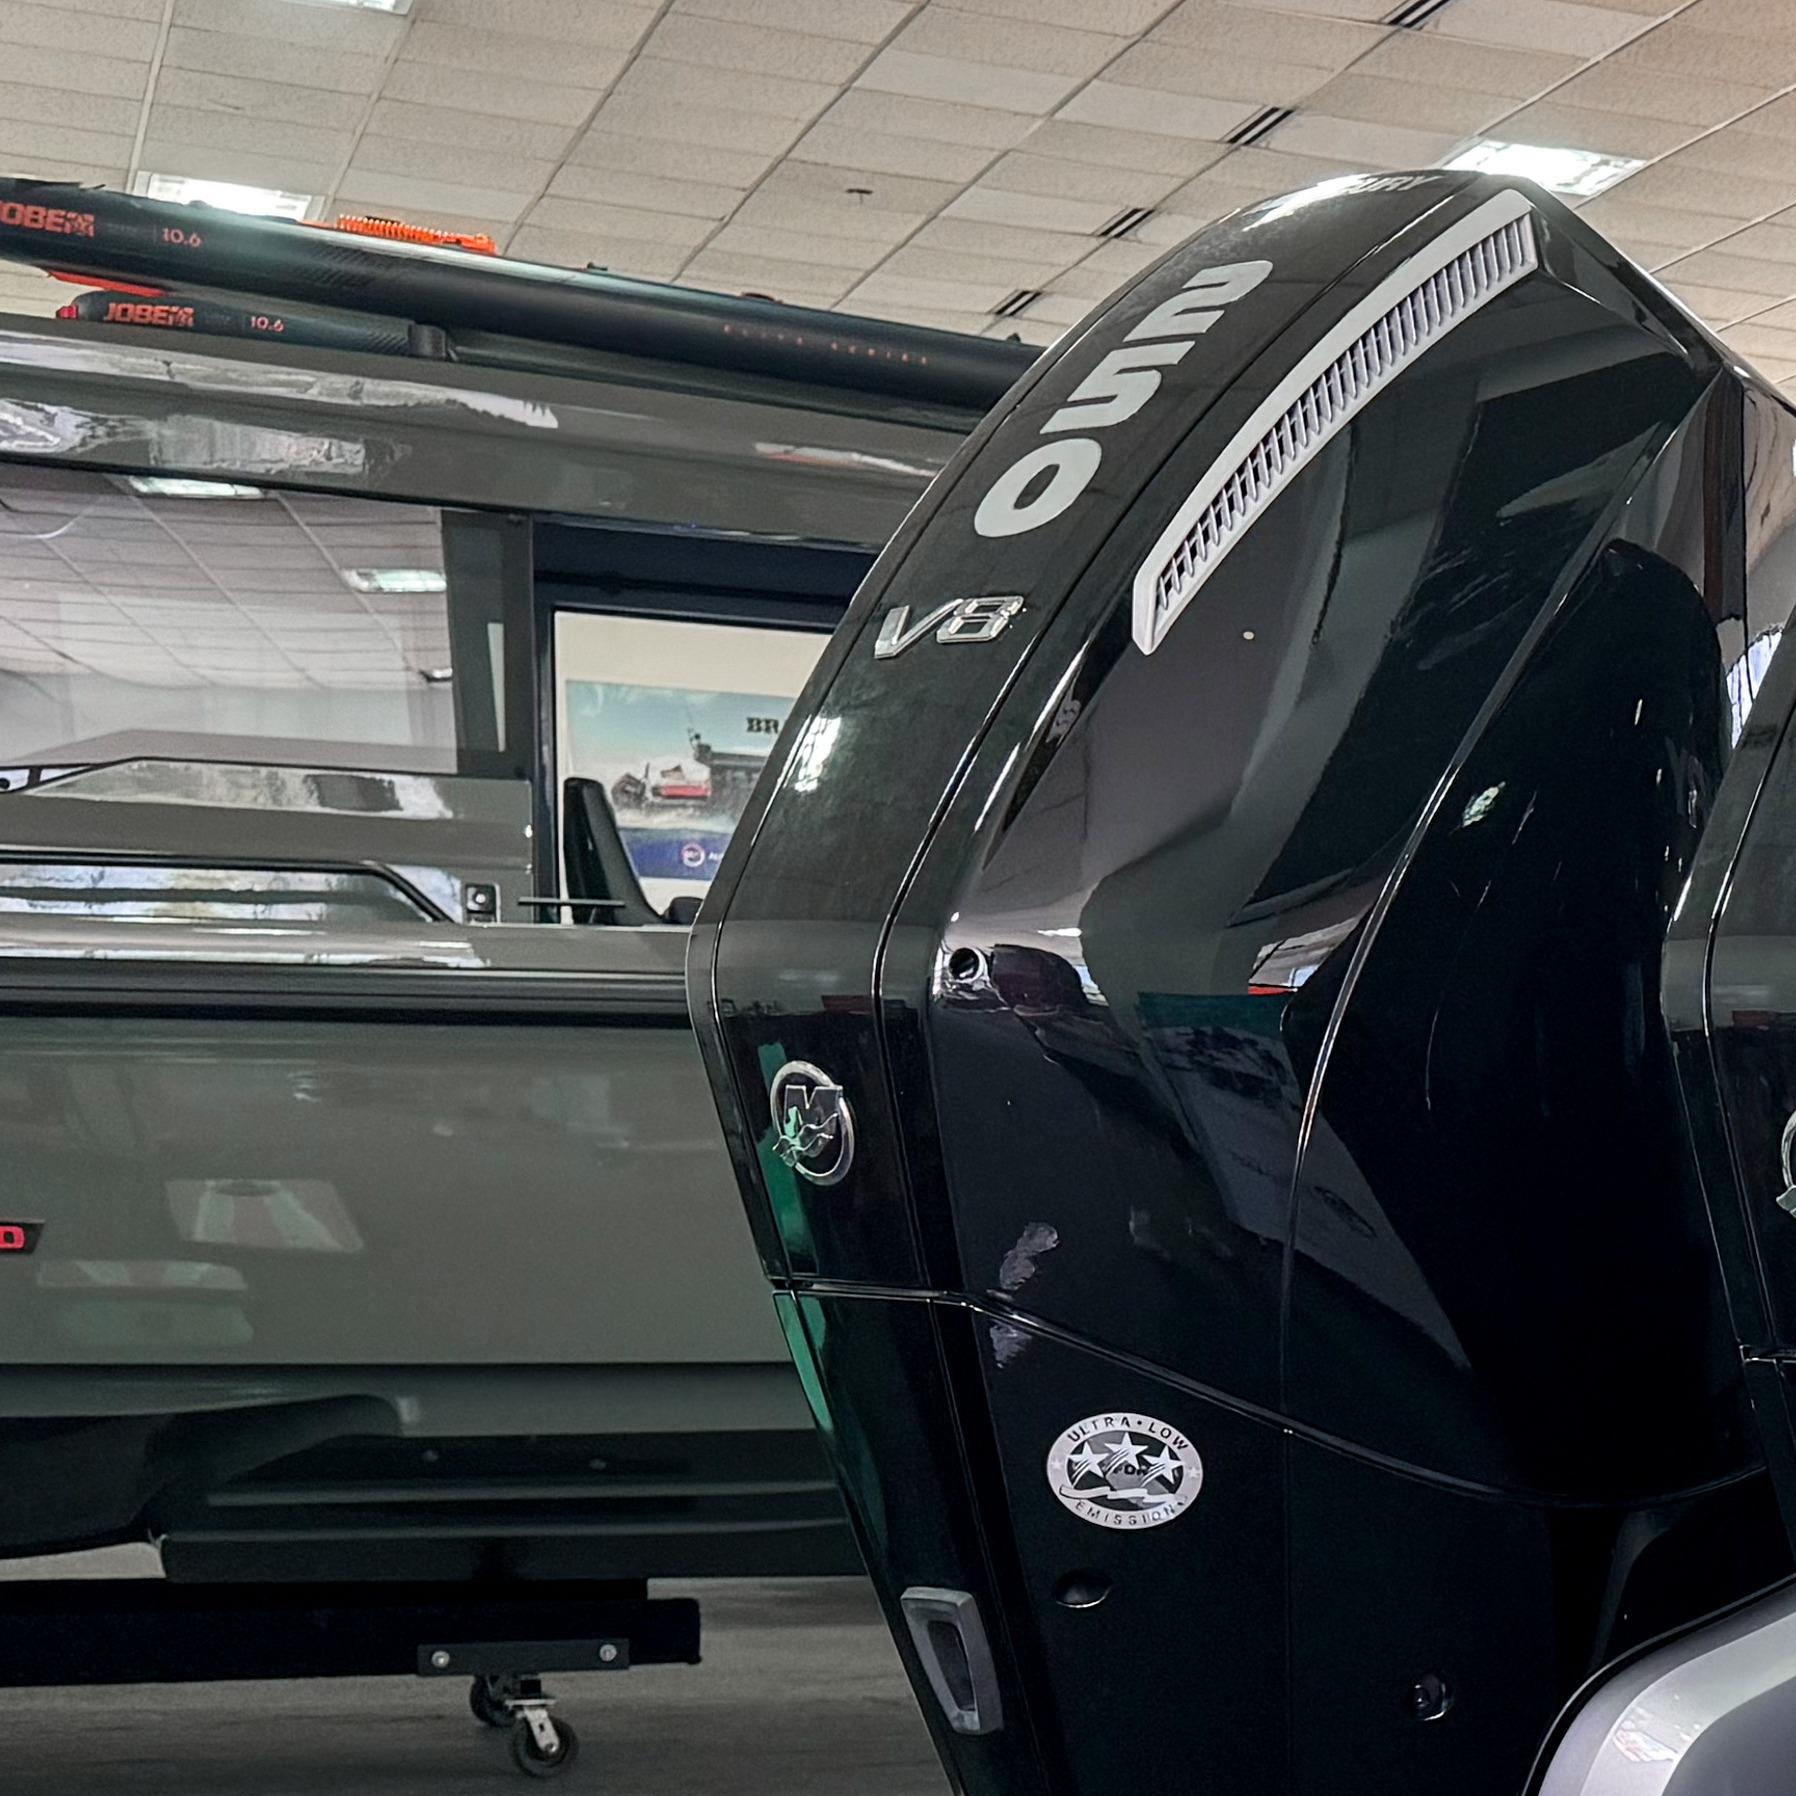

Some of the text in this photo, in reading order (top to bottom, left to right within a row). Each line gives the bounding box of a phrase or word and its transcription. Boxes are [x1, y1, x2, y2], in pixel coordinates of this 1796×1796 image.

[0, 203, 203, 248] OBE 10.6
[250, 315, 285, 333] 10.6
[974, 260, 1273, 537] 250
[874, 595, 1025, 659] V8
[1067, 1416, 1189, 1451] ULTRA LOW
[1074, 1499, 1178, 1526] EMISSION
